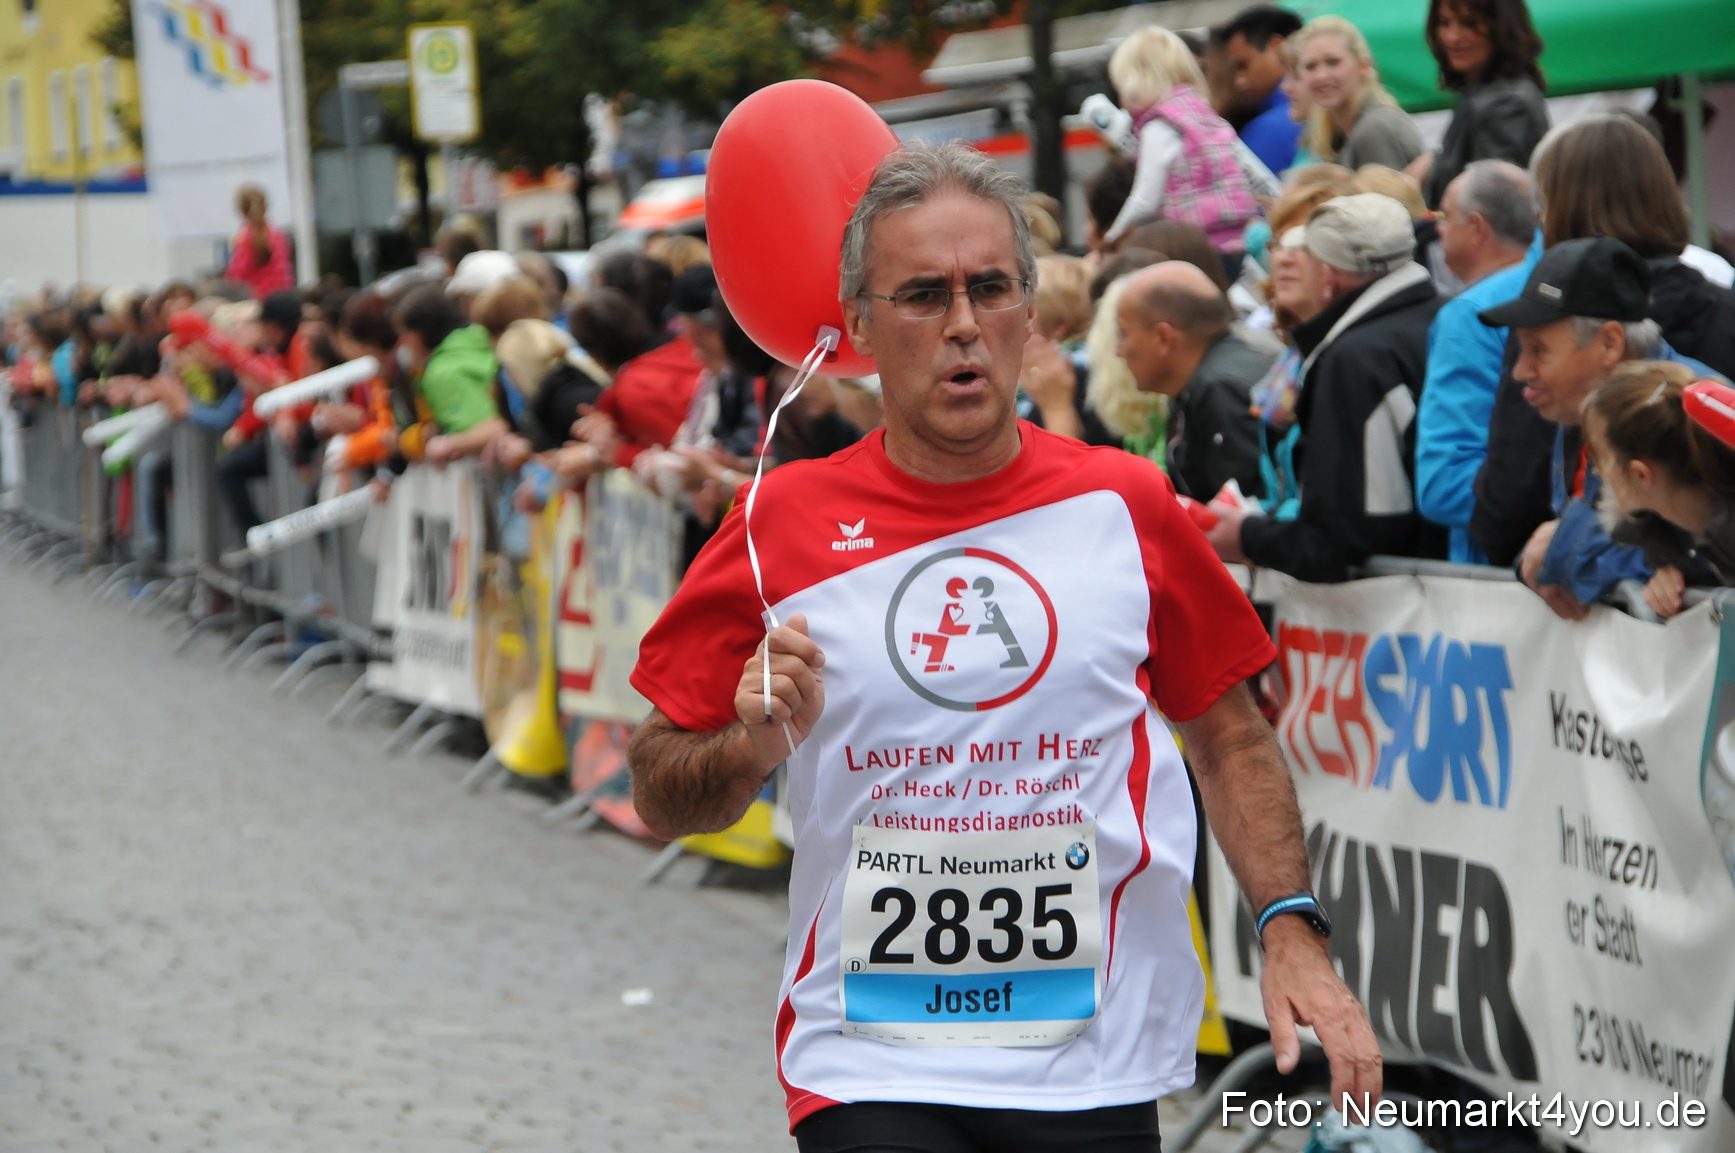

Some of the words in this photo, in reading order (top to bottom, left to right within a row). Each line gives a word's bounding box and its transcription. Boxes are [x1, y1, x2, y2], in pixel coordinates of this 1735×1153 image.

[832, 537, 874, 551] erima
[871, 783, 898, 800] Dr.
[905, 780, 956, 798] Heck
[979, 780, 1008, 796] Dr.
[1016, 773, 1080, 796] Röschl
[873, 804, 1083, 833] Leistungsdiagnostik
[856, 850, 932, 875] PARTL
[940, 852, 1056, 875] Neumarkt
[869, 883, 1078, 965] 2835
[851, 960, 861, 972] D
[925, 981, 1013, 1014] Josef
